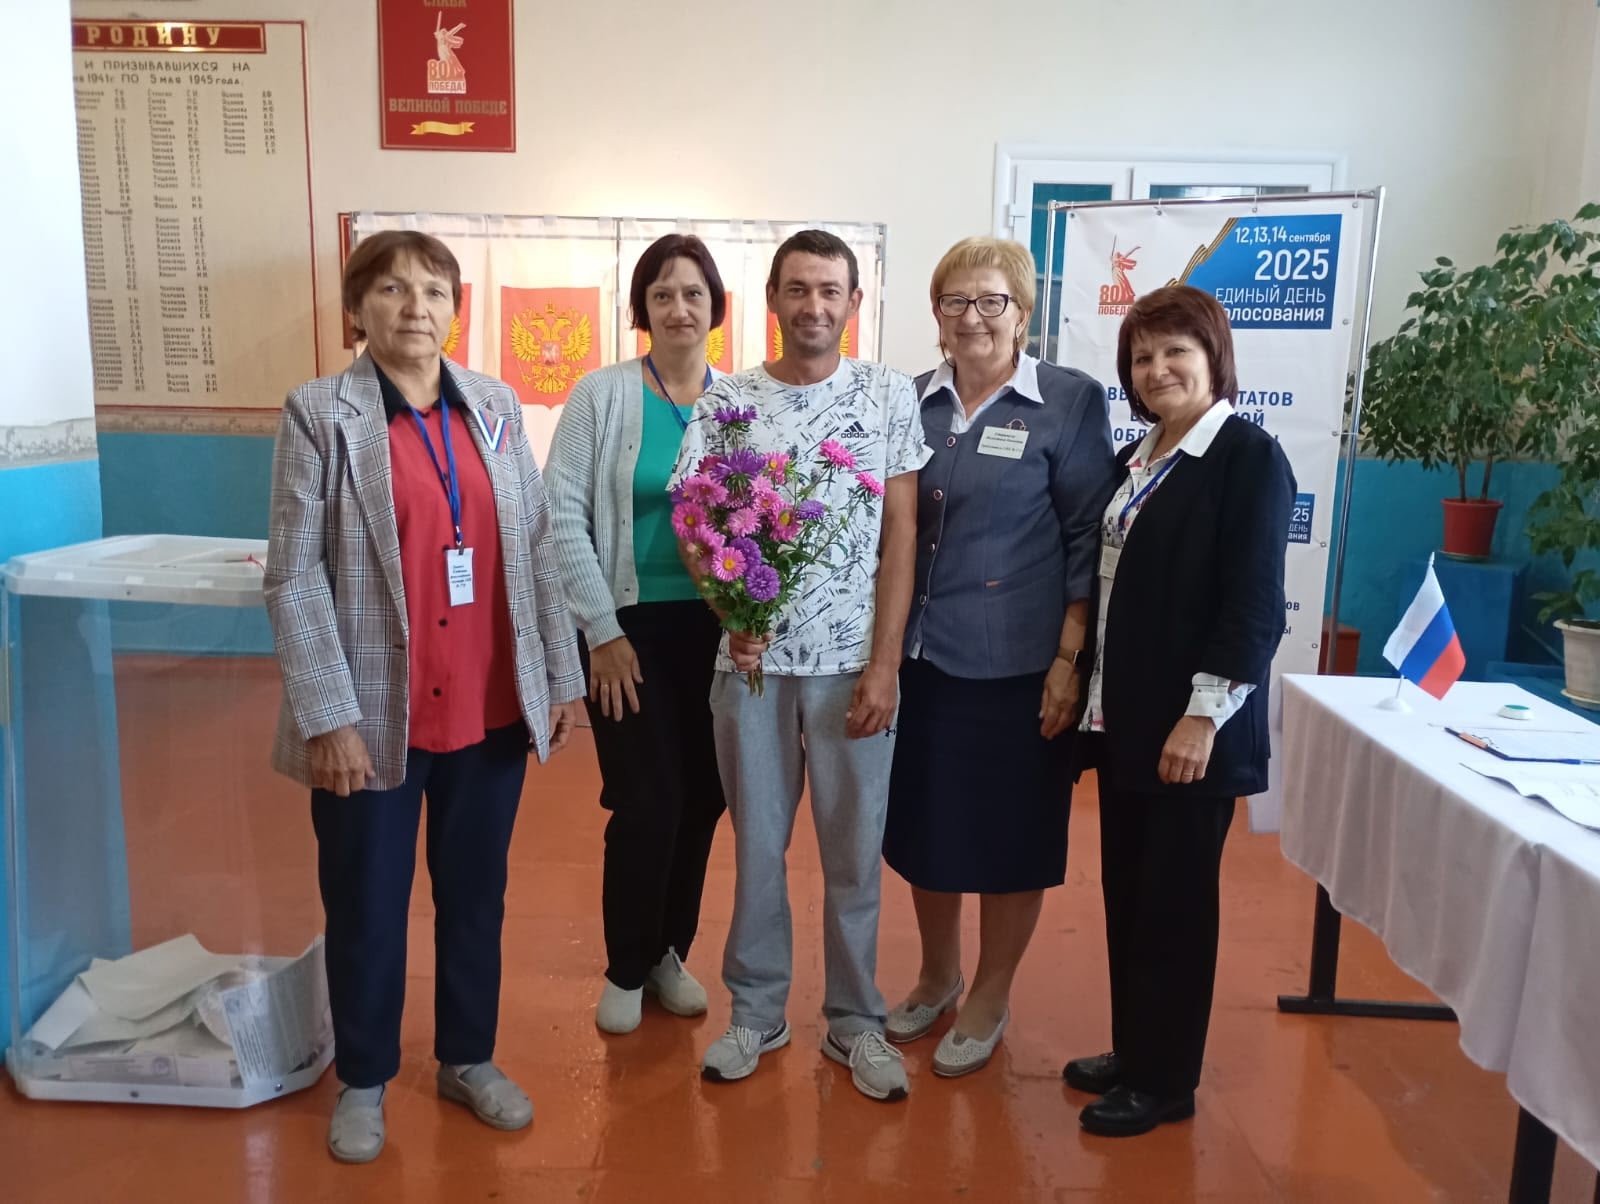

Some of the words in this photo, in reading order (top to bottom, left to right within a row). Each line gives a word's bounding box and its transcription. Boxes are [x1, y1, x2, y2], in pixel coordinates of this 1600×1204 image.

[86, 25, 221, 47] РОДИНУ
[103, 60, 219, 72] ПРИЗЫВАВШИХСЯ
[232, 61, 251, 72] НА
[428, 60, 449, 79] 80
[121, 73, 140, 84] ПО
[389, 97, 450, 112] ВЕЛИКОЙ
[1235, 225, 1287, 245] 12,13,14
[1288, 232, 1331, 244] сентября
[1255, 248, 1330, 280] 2025
[1100, 284, 1121, 304] 80
[1215, 284, 1281, 304] ЕДИНЫЙ
[1283, 287, 1327, 304] ДЕНЬ
[1098, 305, 1131, 316] ПОБЕД
[1222, 307, 1325, 321] олосования
[1238, 390, 1293, 407] ТАТОВ
[841, 431, 869, 439] adidas
[1292, 507, 1311, 522] 25
